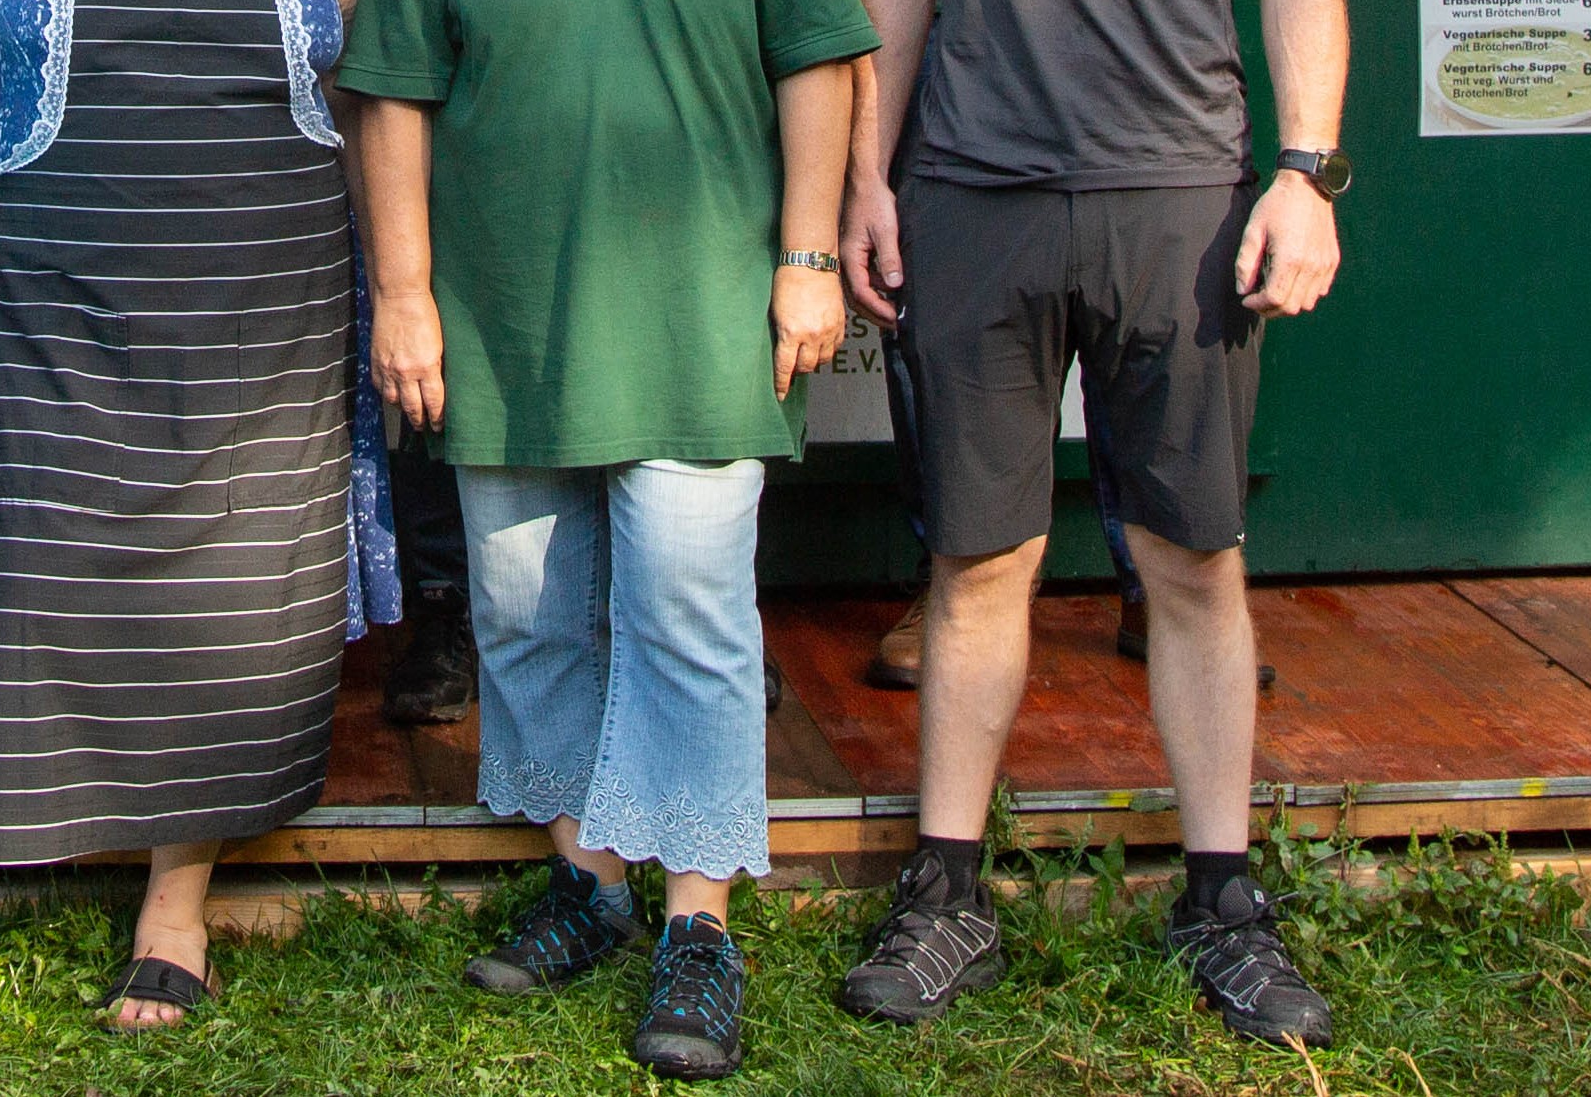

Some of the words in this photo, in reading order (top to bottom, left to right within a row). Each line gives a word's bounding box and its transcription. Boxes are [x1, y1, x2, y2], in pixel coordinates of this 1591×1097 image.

[1452, 8, 1482, 18] wurst
[1485, 7, 1561, 18] Brötchen/Brot
[1443, 28, 1525, 41] Vegetarische
[1528, 28, 1567, 39] Suppe
[1452, 42, 1470, 52] mit
[1443, 63, 1525, 75] Vegetarische
[1528, 62, 1567, 72] Suppe
[1452, 75, 1470, 85] mit
[1472, 76, 1495, 87] veg.
[1498, 75, 1530, 85] Wurst
[1533, 75, 1554, 84] und
[832, 349, 882, 373] E.V.
